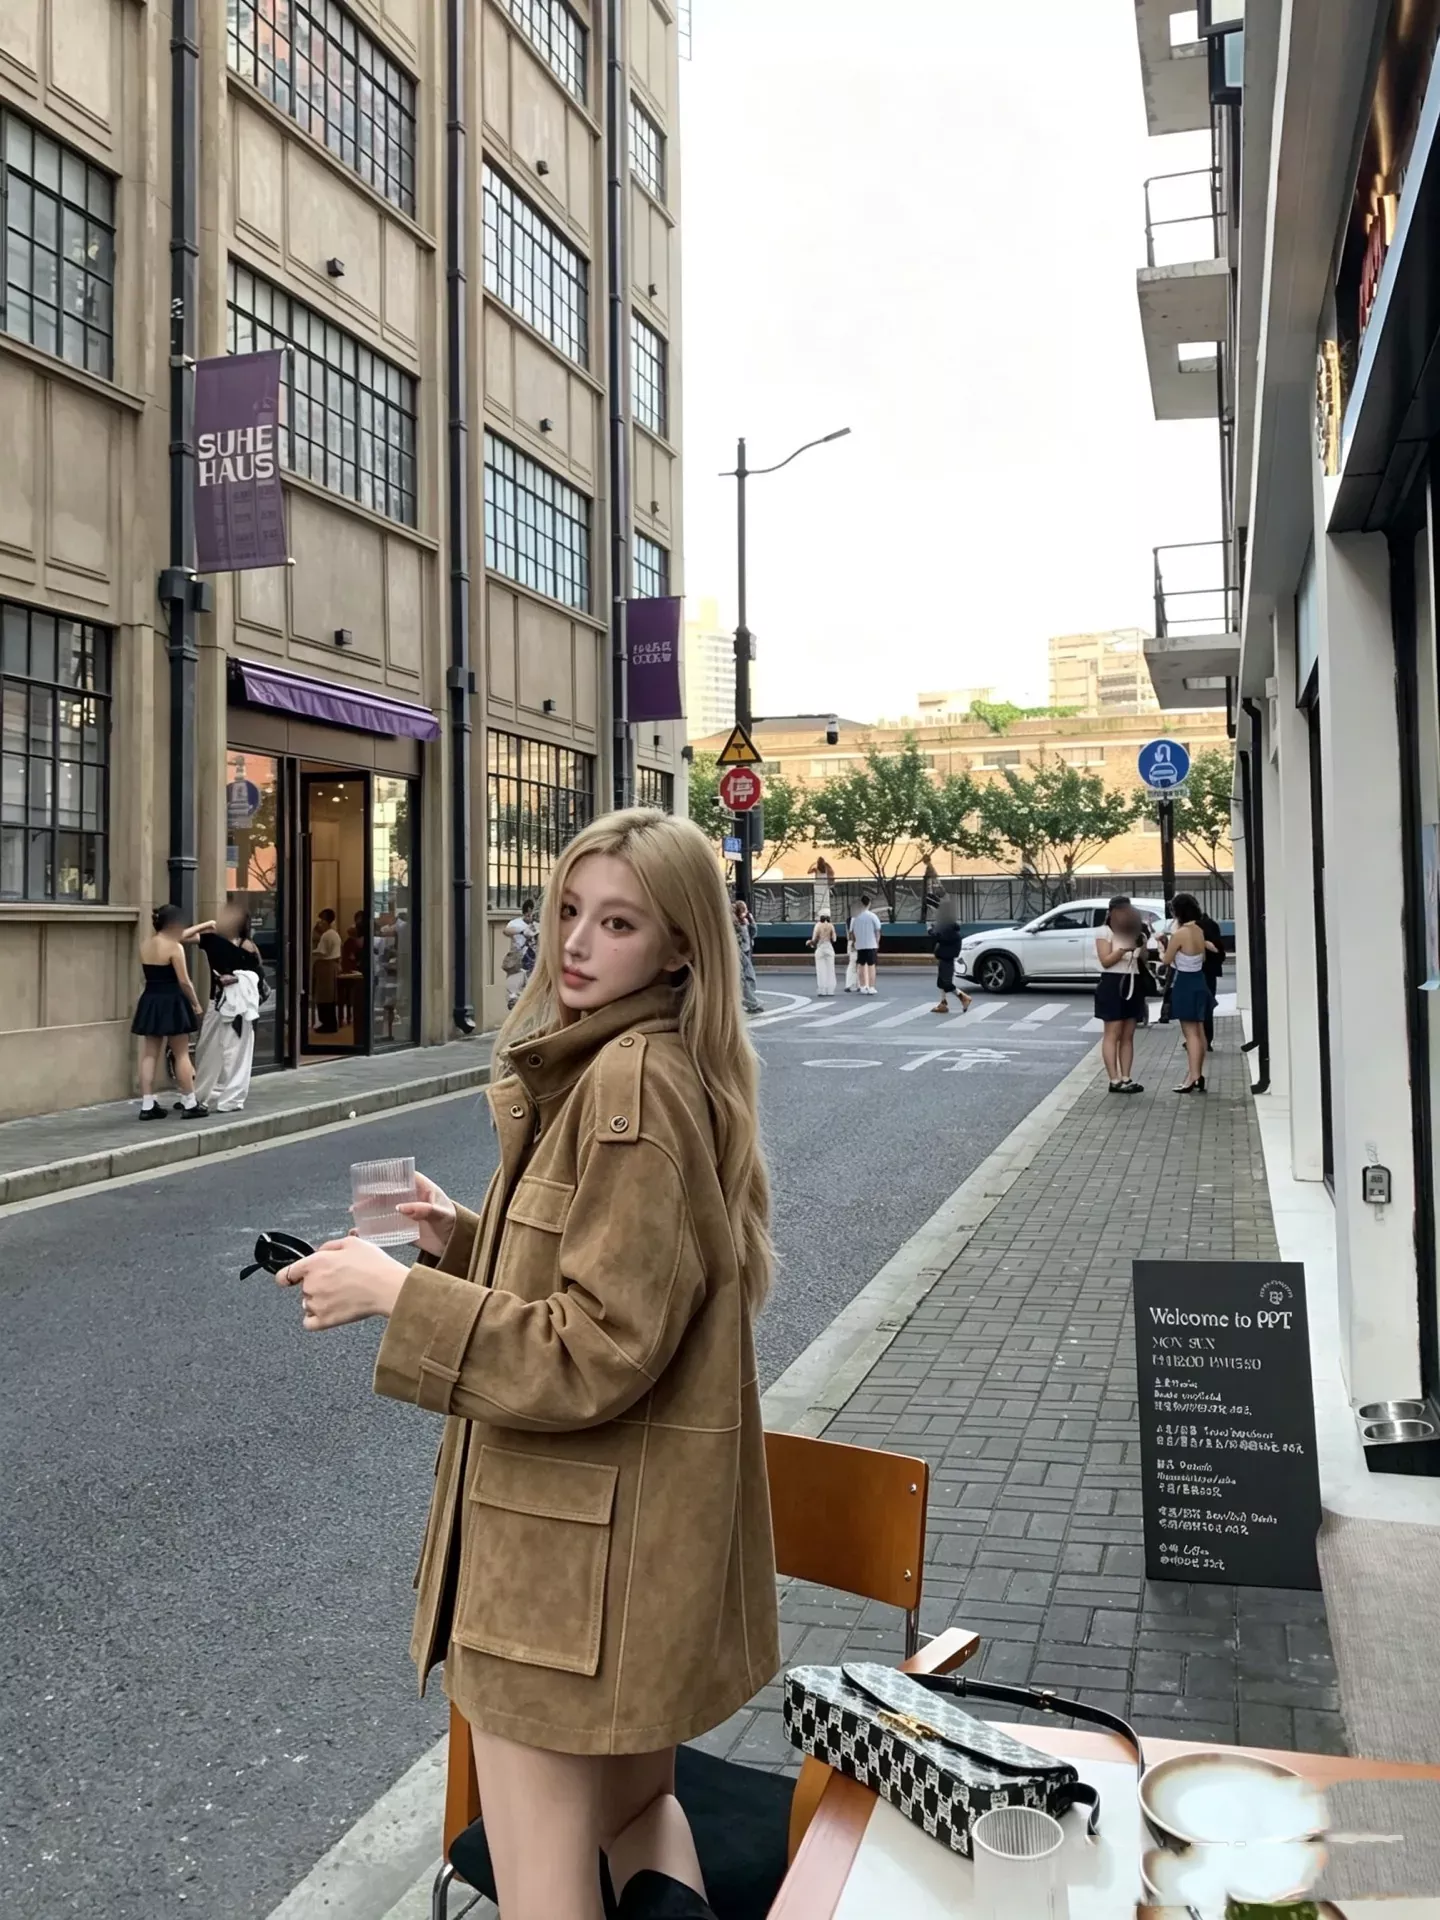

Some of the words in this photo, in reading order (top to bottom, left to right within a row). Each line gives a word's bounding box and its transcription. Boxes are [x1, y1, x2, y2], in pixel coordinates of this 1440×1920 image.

[198, 424, 274, 460] SUHE
[199, 452, 274, 487] HAUS
[727, 775, 754, 805] 停
[1149, 1307, 1229, 1328] Welcome
[1235, 1311, 1252, 1329] to
[1257, 1310, 1293, 1330] PPT
